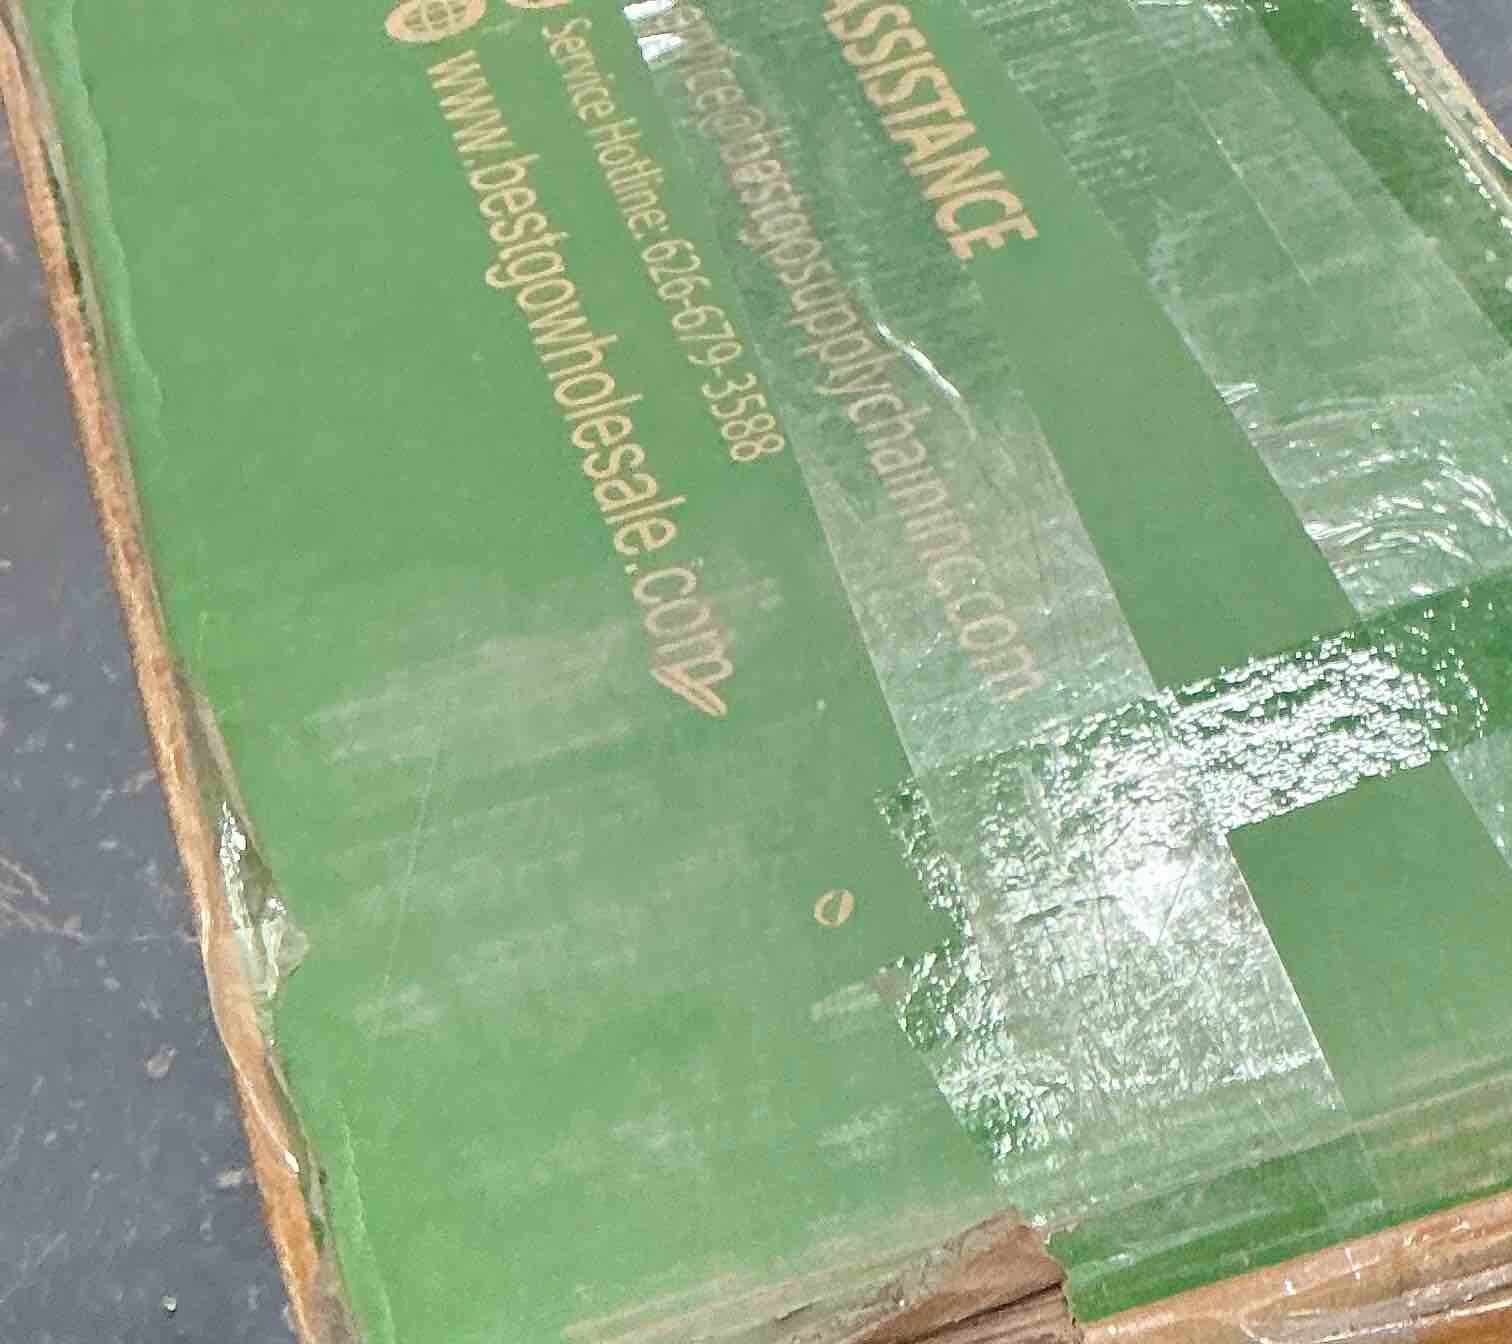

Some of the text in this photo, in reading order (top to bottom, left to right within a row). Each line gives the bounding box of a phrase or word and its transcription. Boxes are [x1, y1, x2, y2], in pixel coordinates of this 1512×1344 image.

[427, 49, 733, 692] www.bestgowholesale.com
[541, 17, 786, 464] Service Hotline: 626-679-3588
